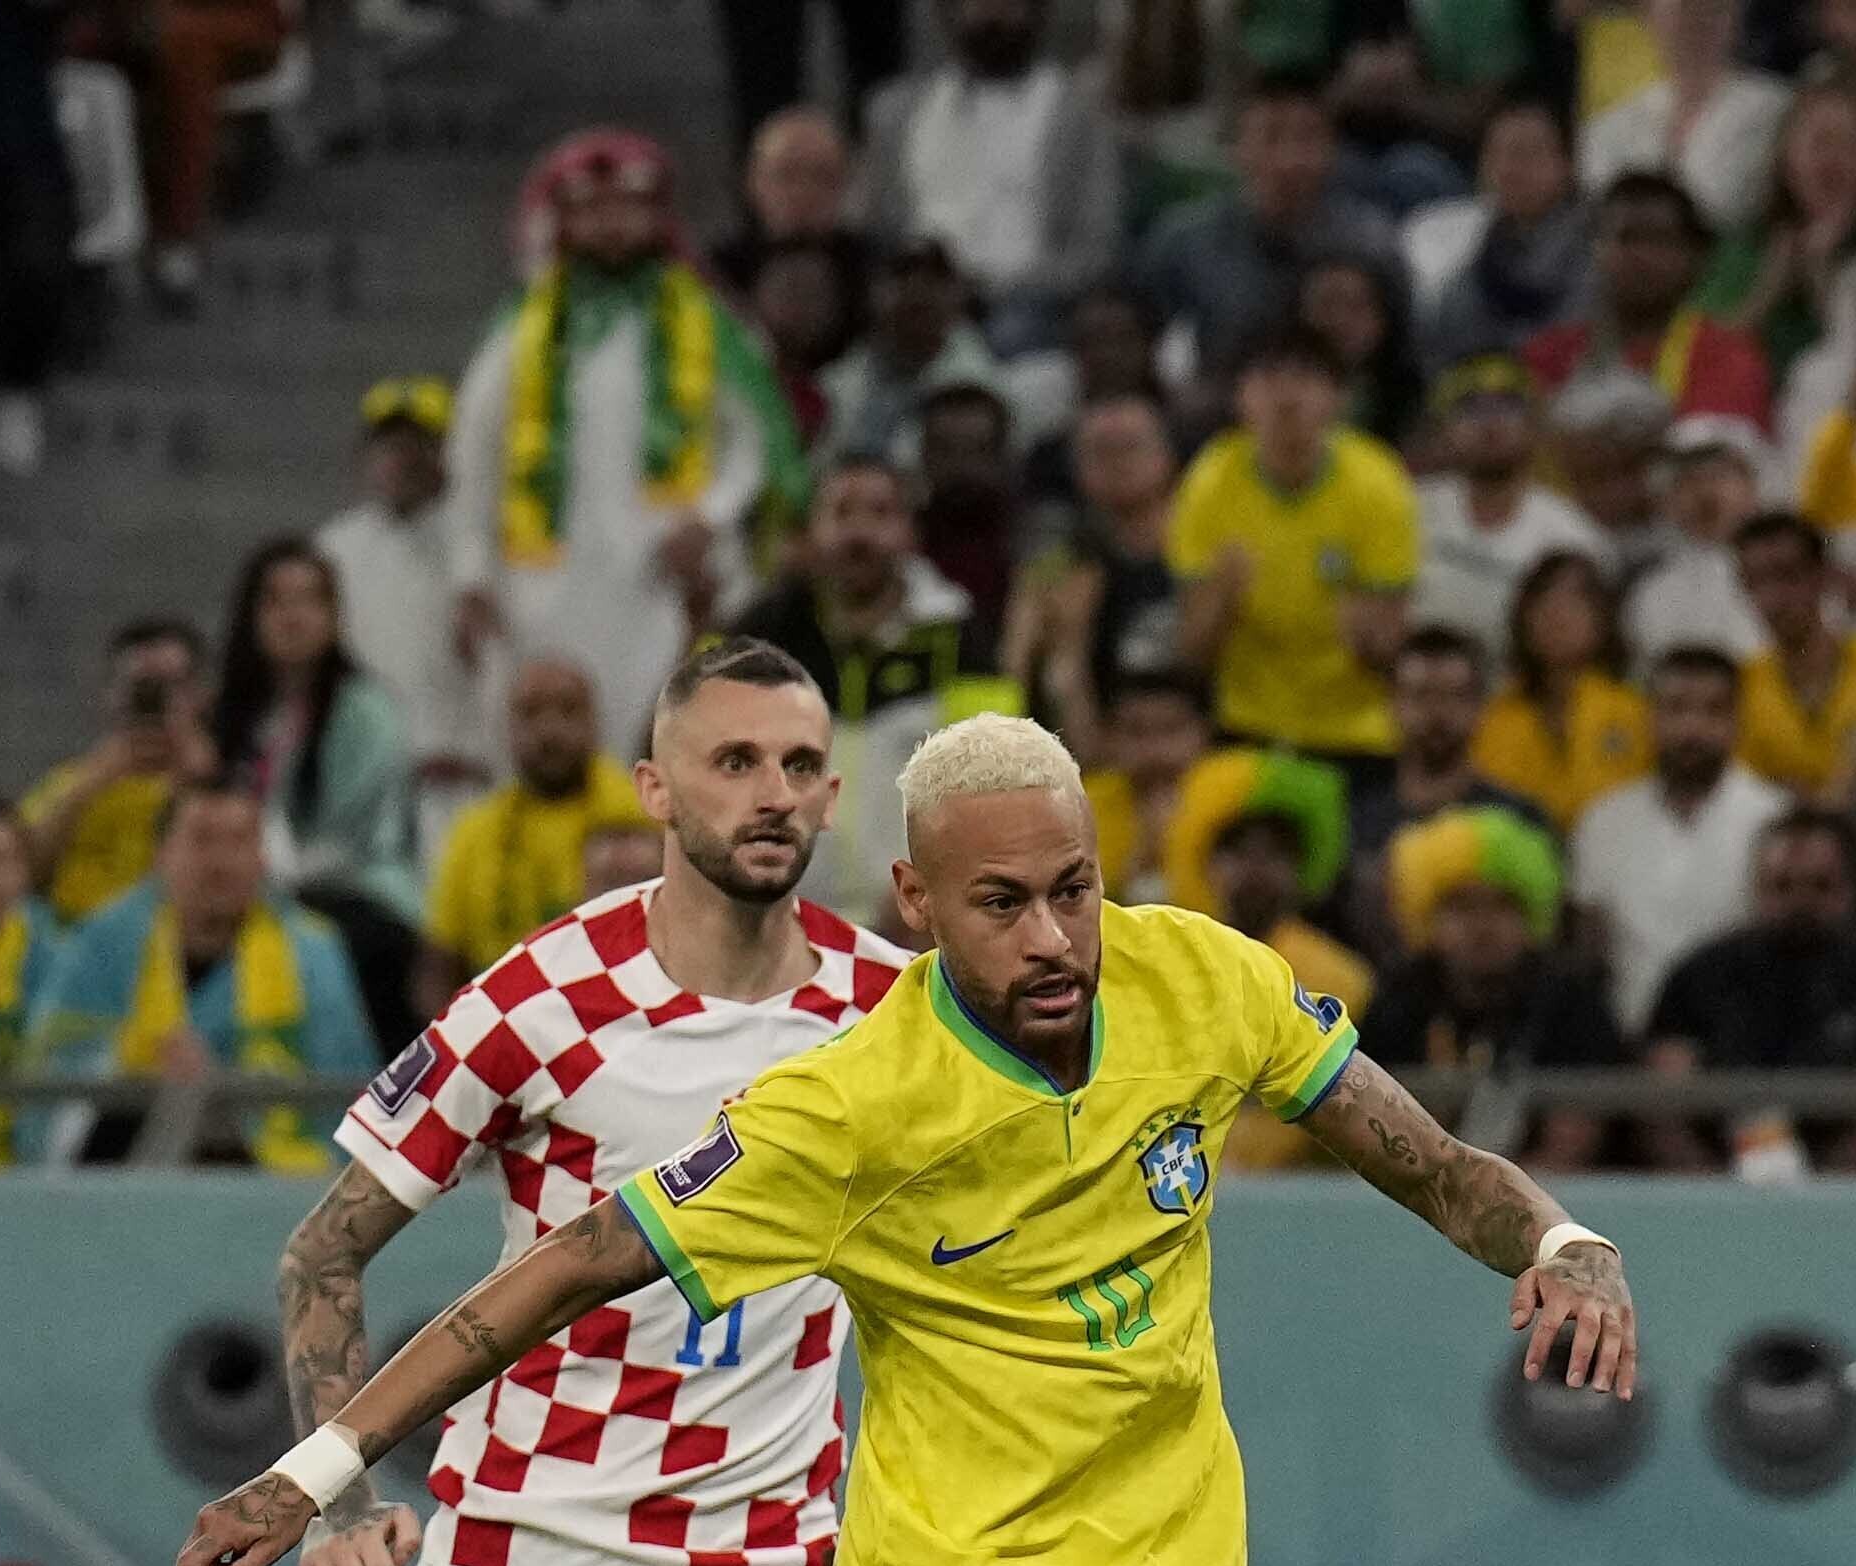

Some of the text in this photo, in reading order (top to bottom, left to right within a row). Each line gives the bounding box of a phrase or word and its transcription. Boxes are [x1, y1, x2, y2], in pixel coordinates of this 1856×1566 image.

[1161, 1154, 1186, 1176] CBF
[675, 1300, 743, 1368] 11
[1057, 1254, 1157, 1353] 10
